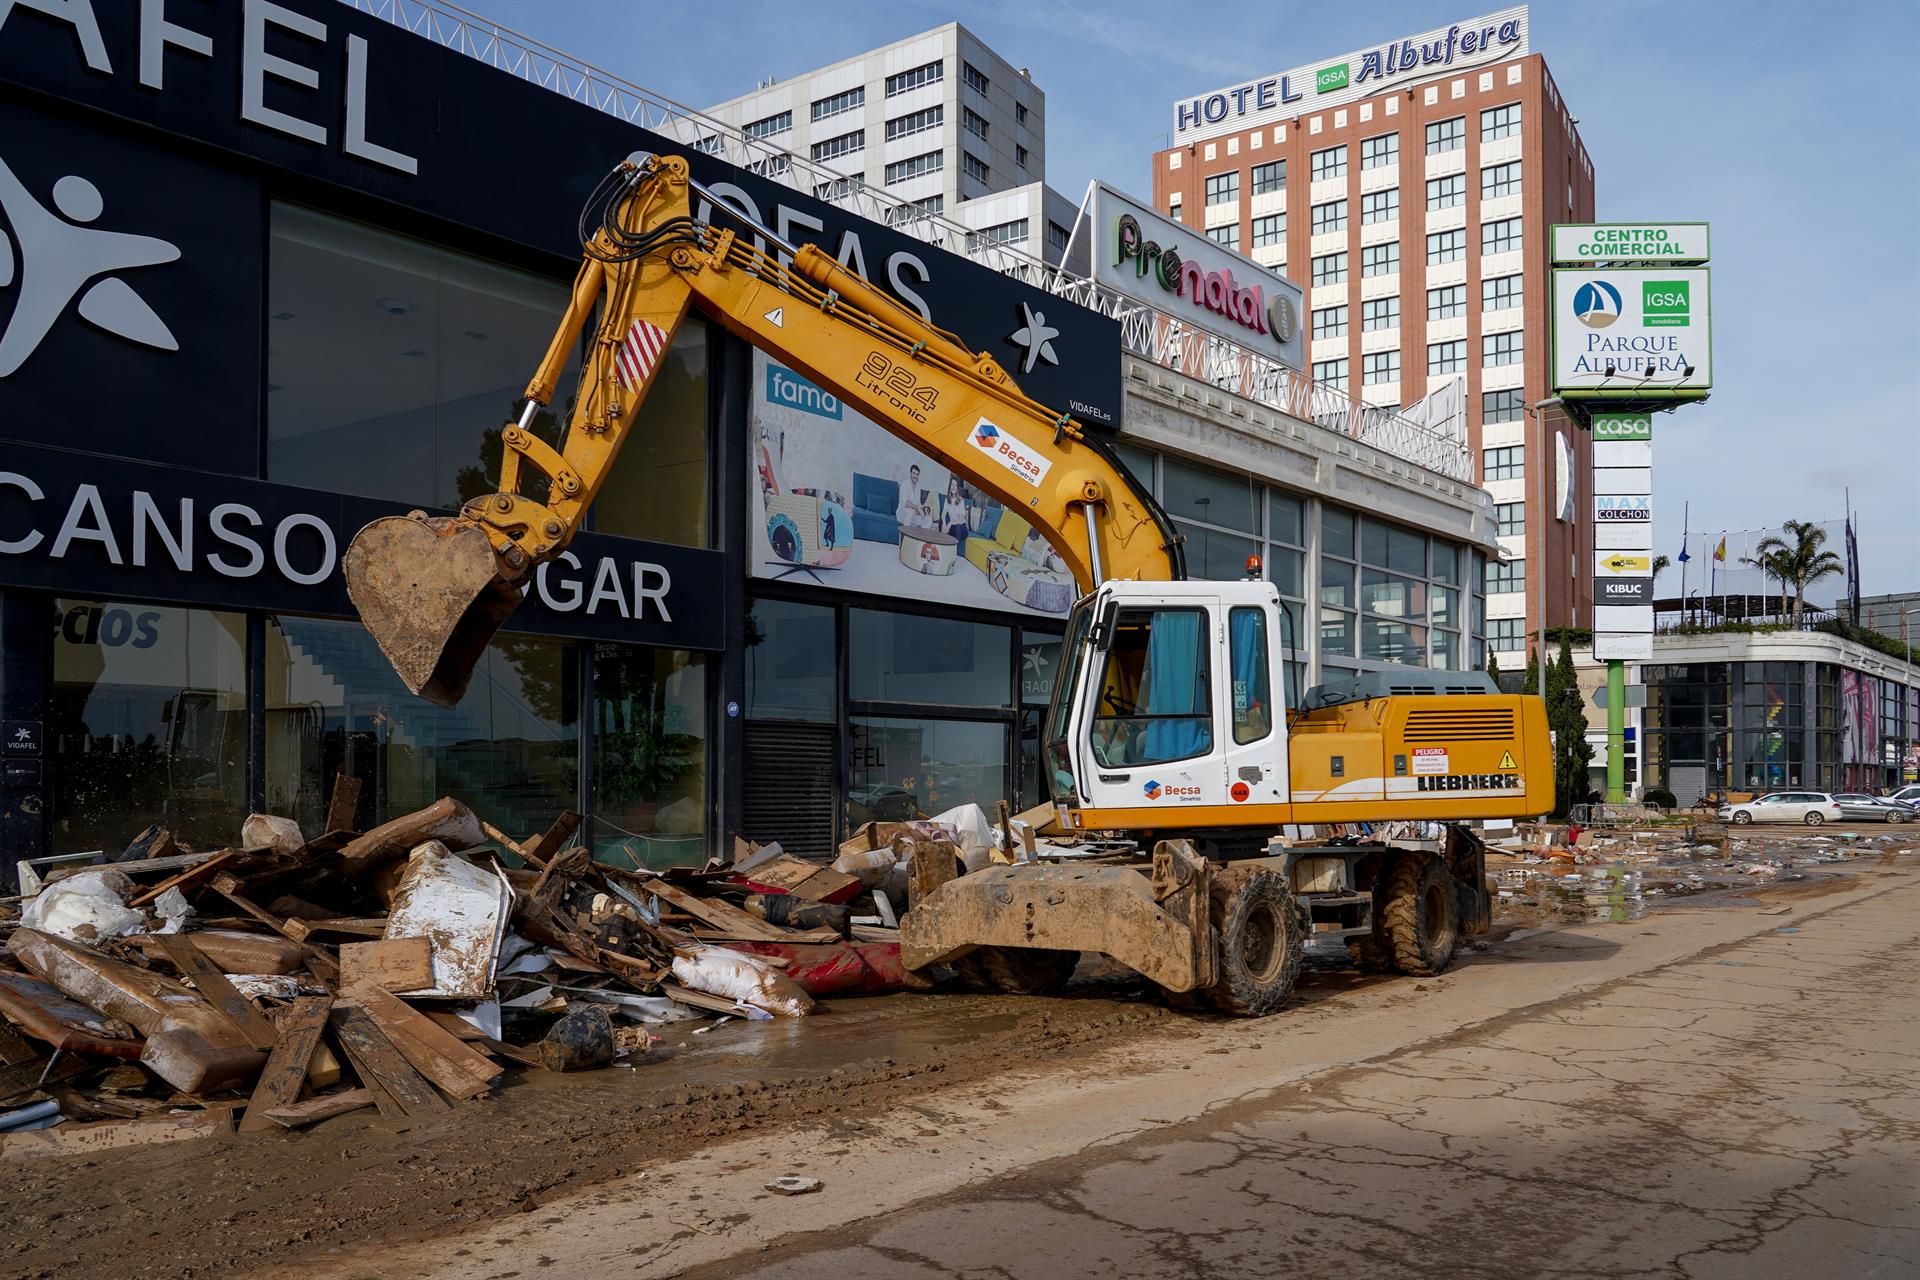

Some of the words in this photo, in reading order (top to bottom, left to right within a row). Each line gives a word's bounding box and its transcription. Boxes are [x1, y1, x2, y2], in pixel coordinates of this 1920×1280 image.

[1177, 76, 1302, 131] HOTEL
[1318, 69, 1346, 88] IGSA
[1355, 17, 1520, 82] Albufera
[1594, 229, 1668, 242] CENTRO
[1578, 243, 1685, 256] COMERCIAL
[1647, 293, 1687, 307] IGSA
[1587, 333, 1678, 355] PARQUE
[1573, 352, 1691, 373] ALBUFERA
[862, 350, 940, 413] 924
[772, 373, 838, 414] fama
[855, 371, 927, 425] Litronic
[1070, 399, 1111, 421] VIDAFEL.es
[1596, 418, 1649, 435] casa
[998, 441, 1041, 476] Becsa
[1598, 497, 1649, 509] MAX
[1598, 510, 1649, 519] COLCHON
[522, 551, 672, 622] GAR
[1606, 584, 1642, 593] KIBUC
[8, 742, 37, 750] VIDAFEL
[1165, 785, 1201, 796] Becsa
[1417, 773, 1519, 791] LIEBHERR
